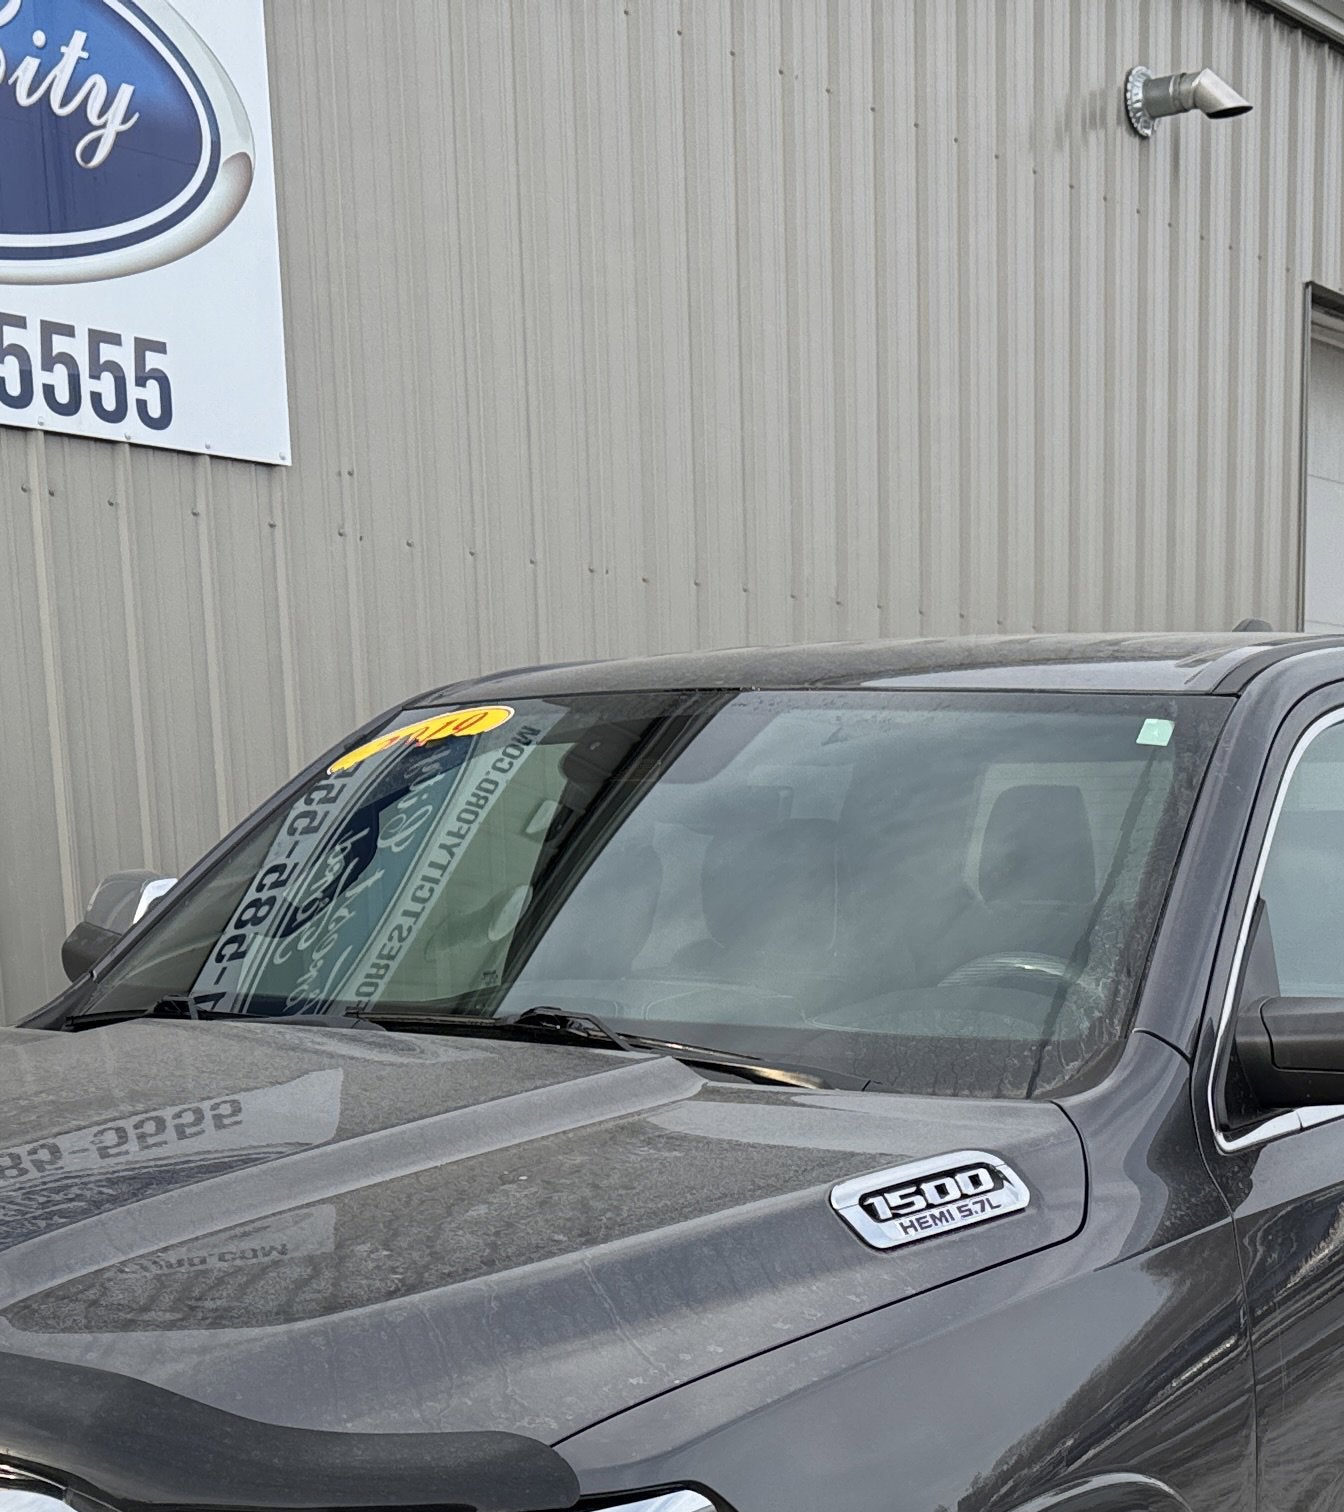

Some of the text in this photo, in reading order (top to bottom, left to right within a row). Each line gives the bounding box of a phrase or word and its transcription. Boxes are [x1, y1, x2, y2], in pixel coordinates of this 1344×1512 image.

[862, 1167, 995, 1220] 1500
[898, 1197, 1002, 1236] HEMI 5.7L
